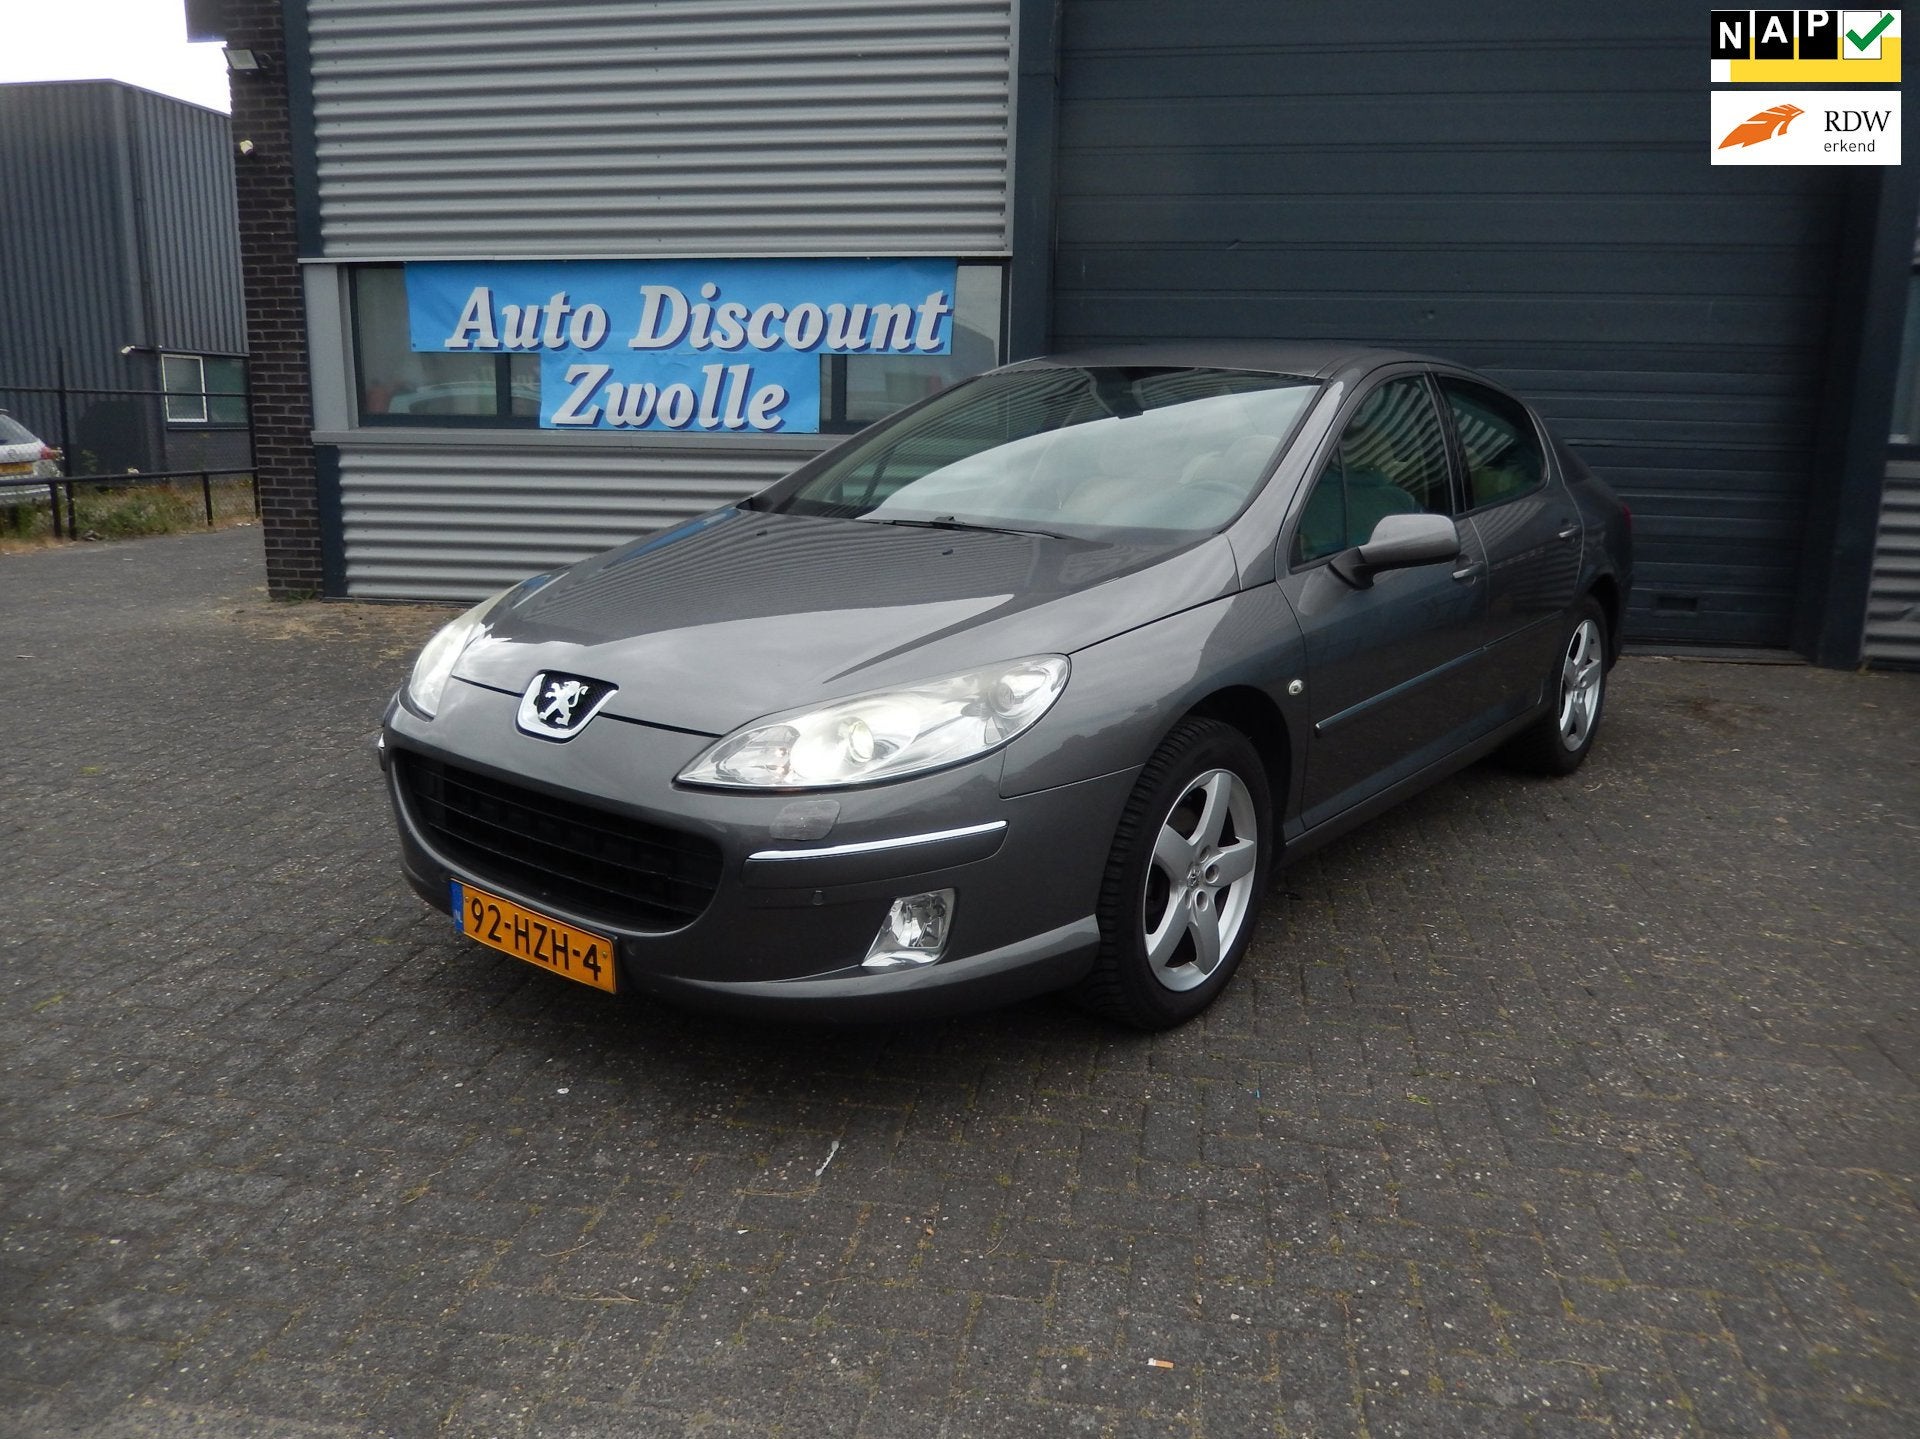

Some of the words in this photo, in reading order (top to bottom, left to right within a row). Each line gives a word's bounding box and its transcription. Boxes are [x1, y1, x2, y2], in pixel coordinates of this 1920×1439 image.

[445, 286, 608, 350] Auto
[628, 282, 951, 351] Discount
[551, 363, 788, 430] Zwolle
[471, 897, 602, 982] 92-HZH-4
